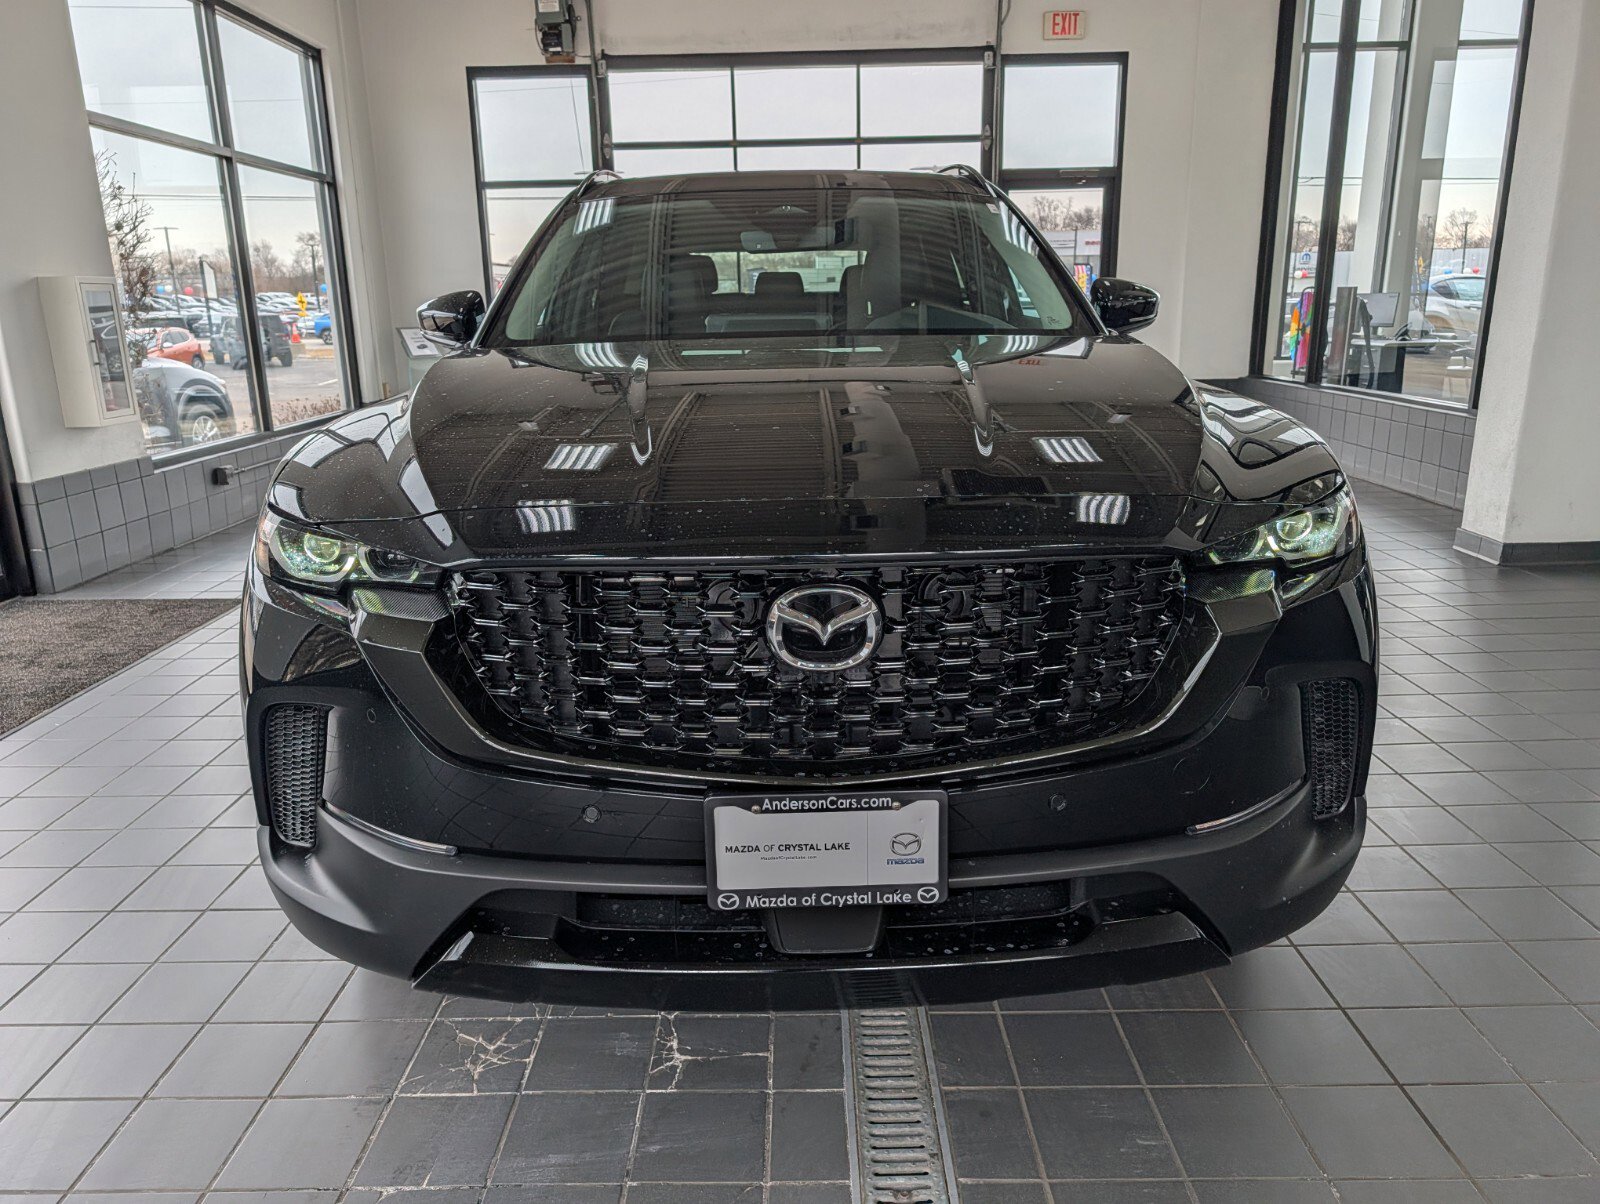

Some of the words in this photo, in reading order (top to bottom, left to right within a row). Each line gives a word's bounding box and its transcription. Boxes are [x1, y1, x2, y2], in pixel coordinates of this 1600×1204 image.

[1052, 12, 1080, 36] EXIT
[761, 796, 892, 811] AndersonCars.com
[725, 844, 761, 854] MAZDA
[763, 844, 775, 853] OF
[777, 843, 822, 852] CRYSTAL
[824, 842, 851, 851] LAKE
[745, 893, 797, 908] Mazda
[801, 893, 817, 906] of
[820, 891, 872, 908] Crystal
[876, 889, 912, 904] Lake
